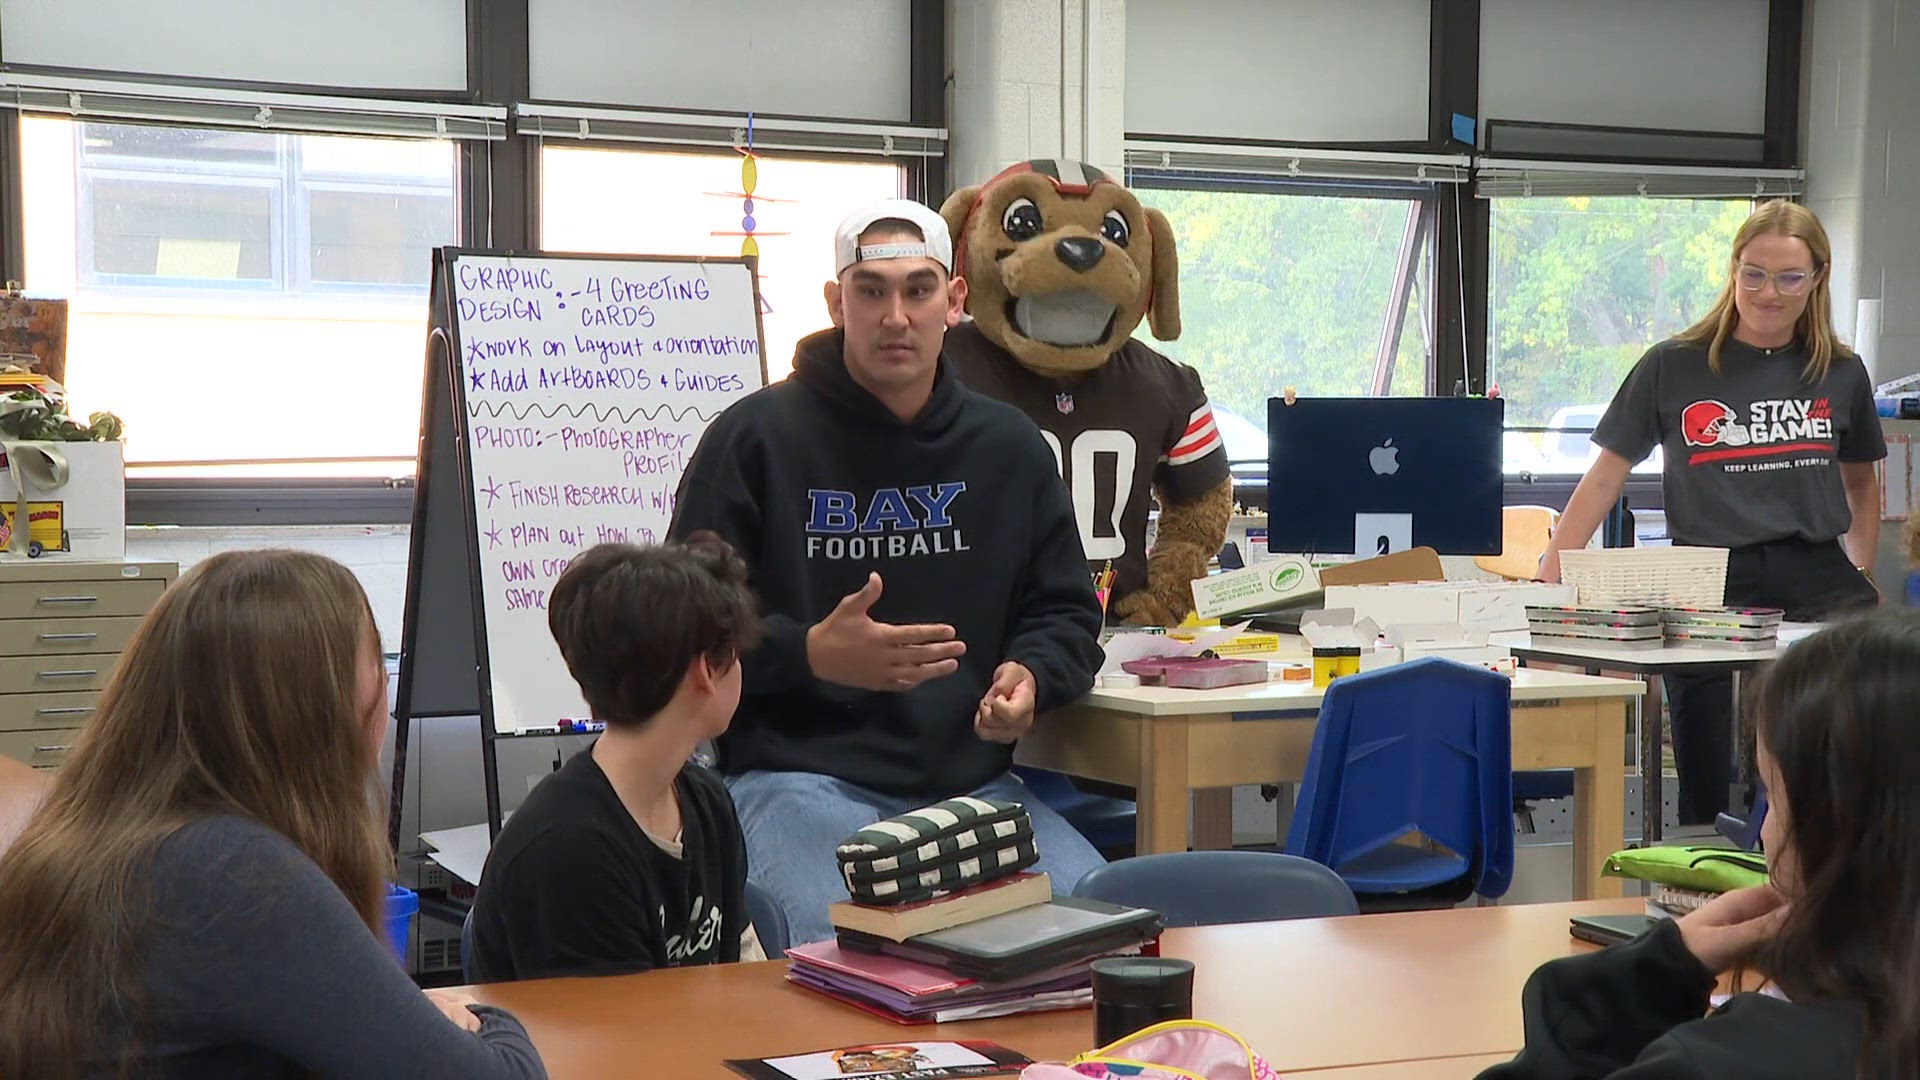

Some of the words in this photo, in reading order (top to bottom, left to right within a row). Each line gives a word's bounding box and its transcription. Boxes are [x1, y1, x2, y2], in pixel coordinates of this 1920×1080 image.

[460, 264, 553, 292] GRAPHIC
[581, 304, 655, 328] CARDS
[1750, 399, 1812, 423] STAY
[1750, 419, 1833, 444] GAME!
[1724, 464, 1746, 473] KEEP
[805, 481, 967, 533] BAY
[807, 529, 971, 560] FOOTBALL
